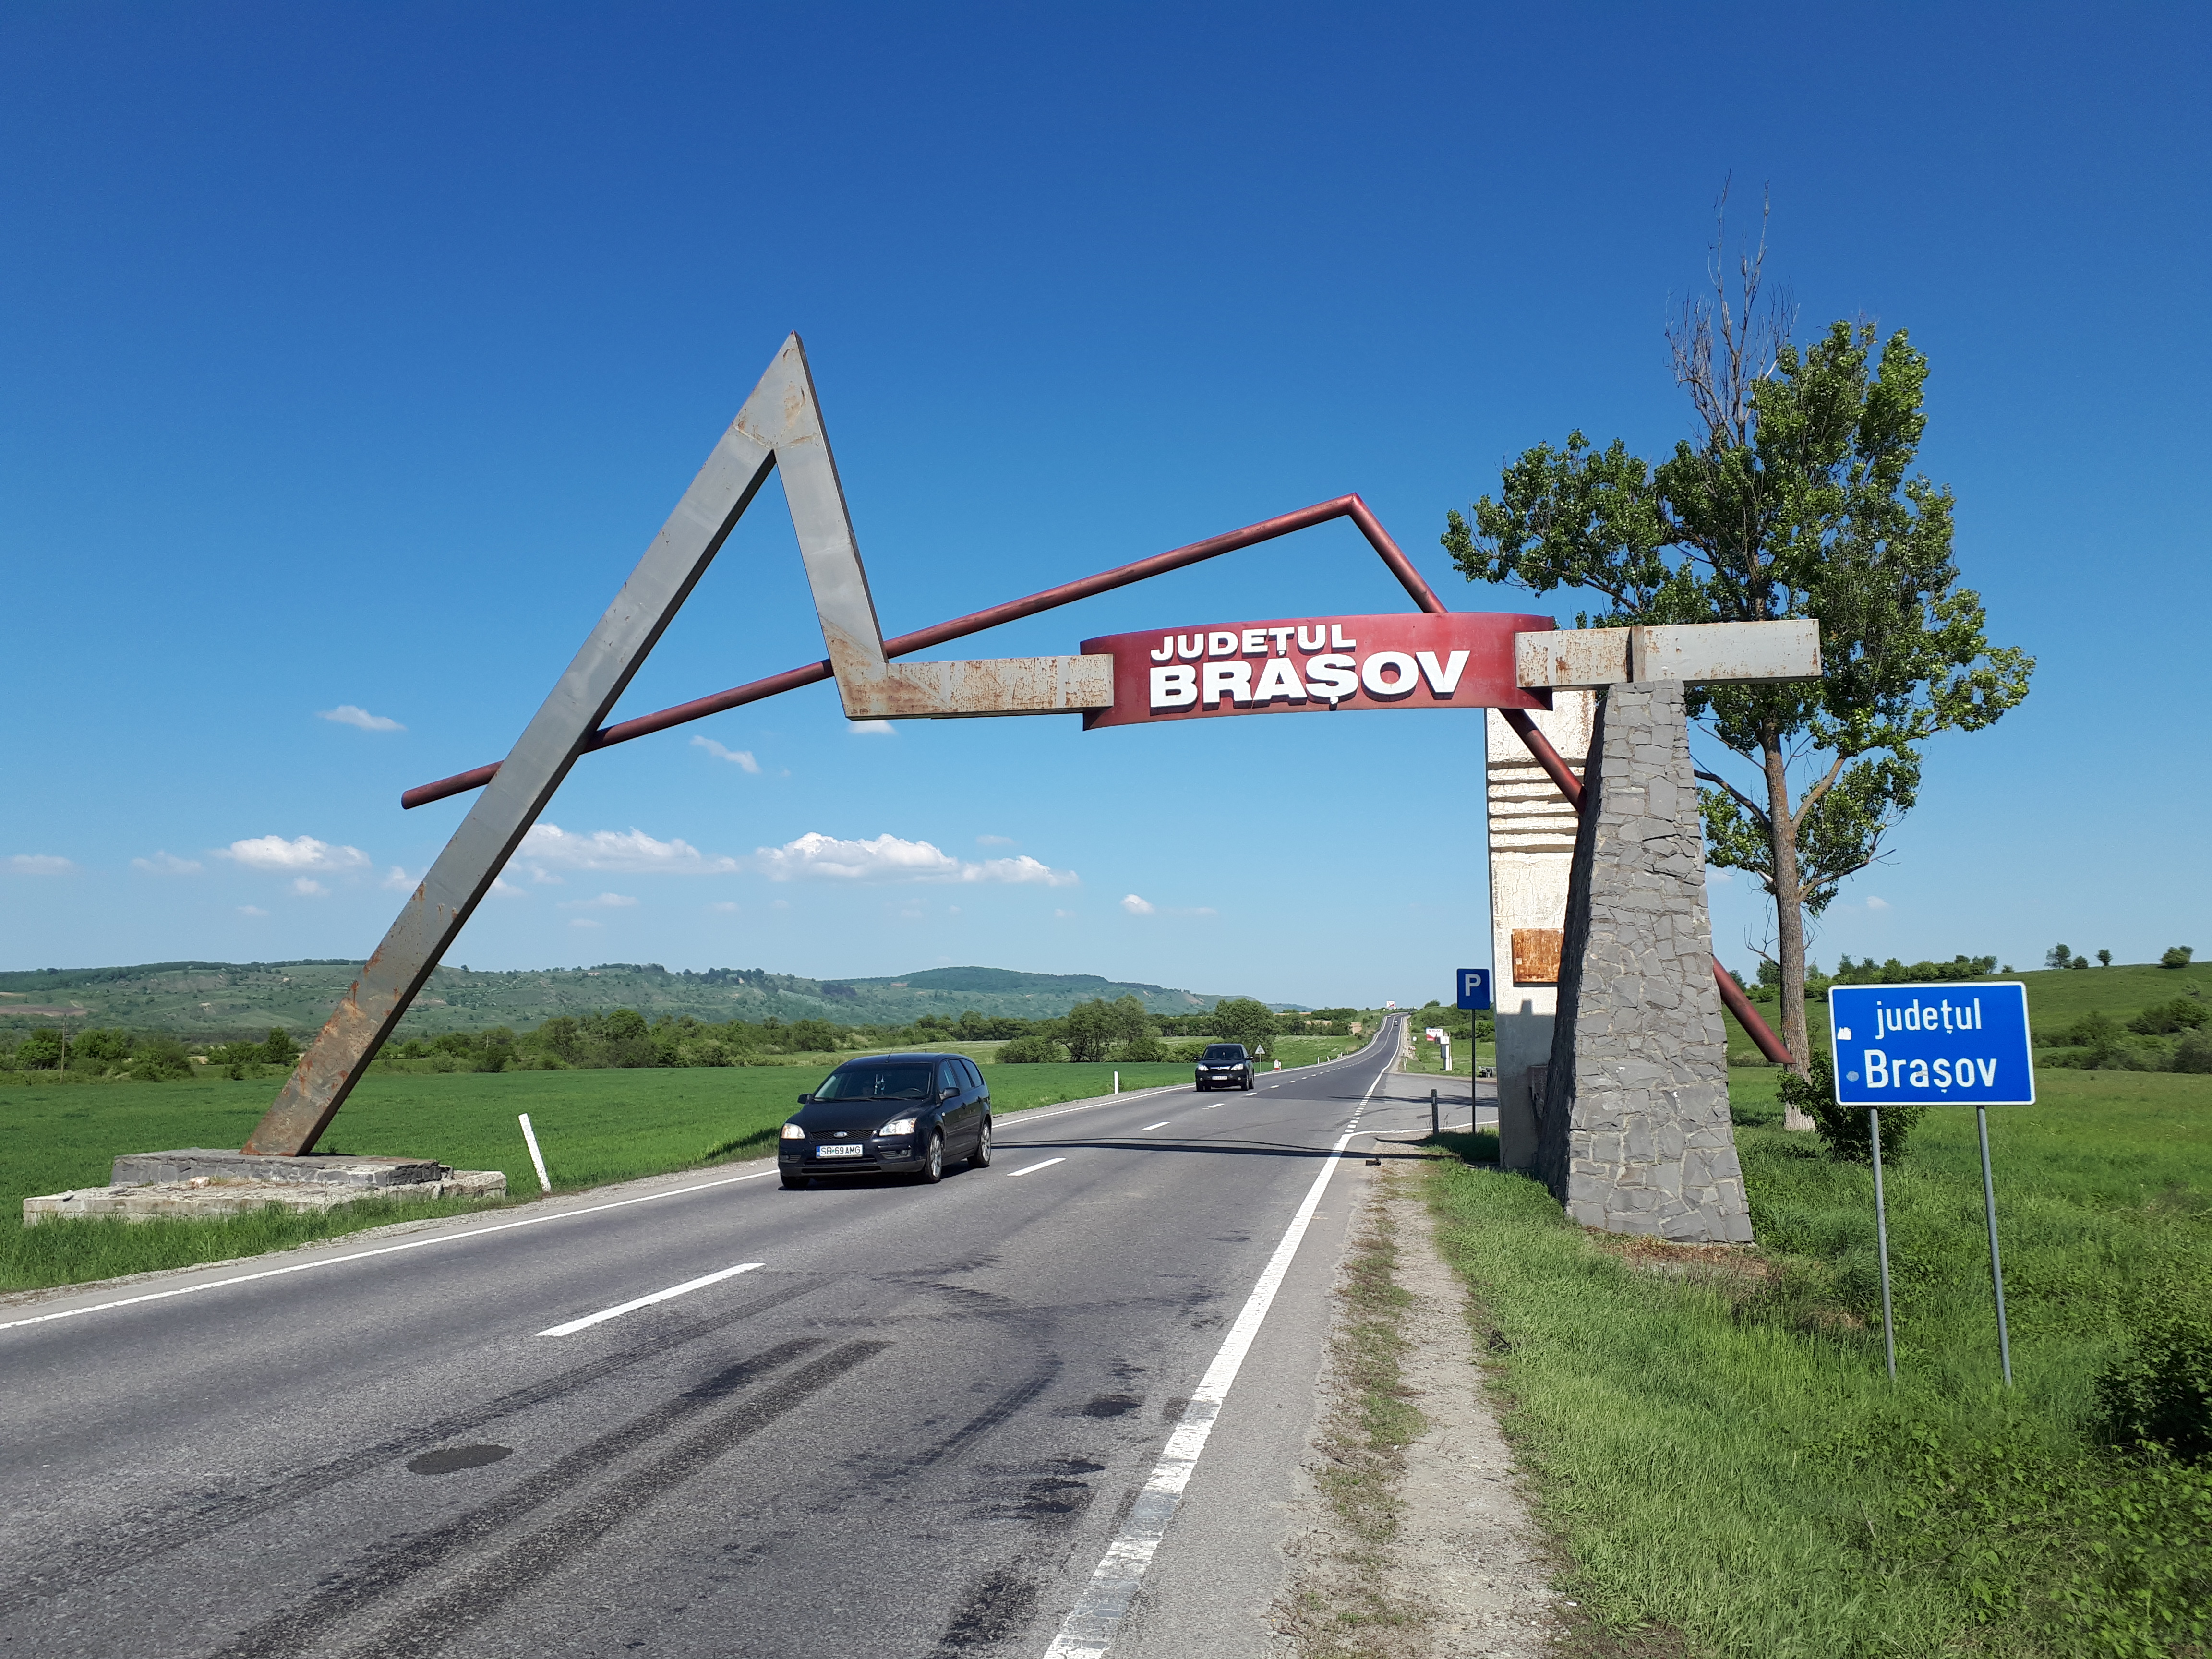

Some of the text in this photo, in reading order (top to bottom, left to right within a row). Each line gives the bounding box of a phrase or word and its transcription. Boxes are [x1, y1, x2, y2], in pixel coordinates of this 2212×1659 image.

[1150, 649, 1470, 710] BRAȘOV
[1465, 974, 1481, 997] P
[1875, 998, 1982, 1040] județul
[1864, 1049, 1997, 1093] Brașov
[821, 1146, 860, 1155] SB 69 AMG
